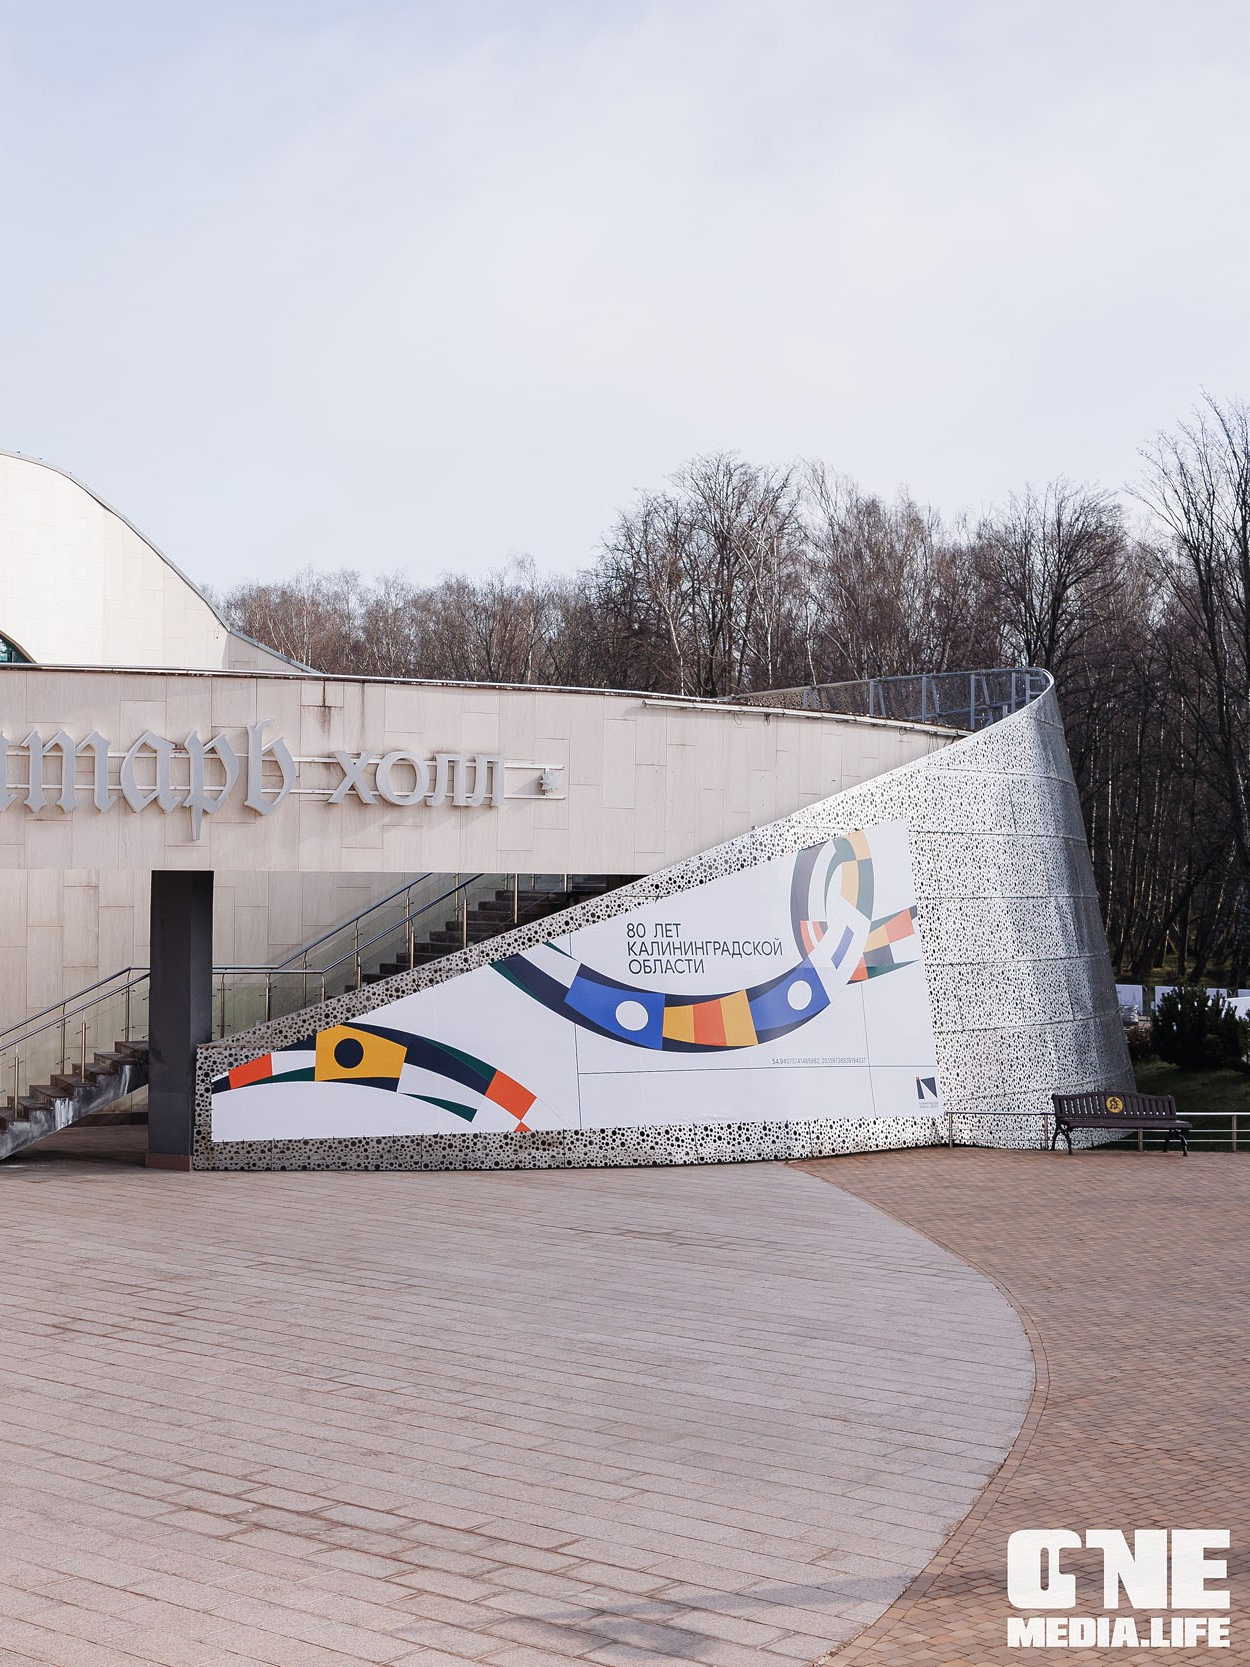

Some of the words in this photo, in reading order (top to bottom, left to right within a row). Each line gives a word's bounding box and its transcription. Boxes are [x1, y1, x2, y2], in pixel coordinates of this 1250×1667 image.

[626, 923, 646, 938] 80
[653, 923, 681, 938] ЛЕТ
[627, 938, 783, 958] КАЛИНИНГРАДСКОЙ
[628, 959, 705, 974] ОБЛАСТИ
